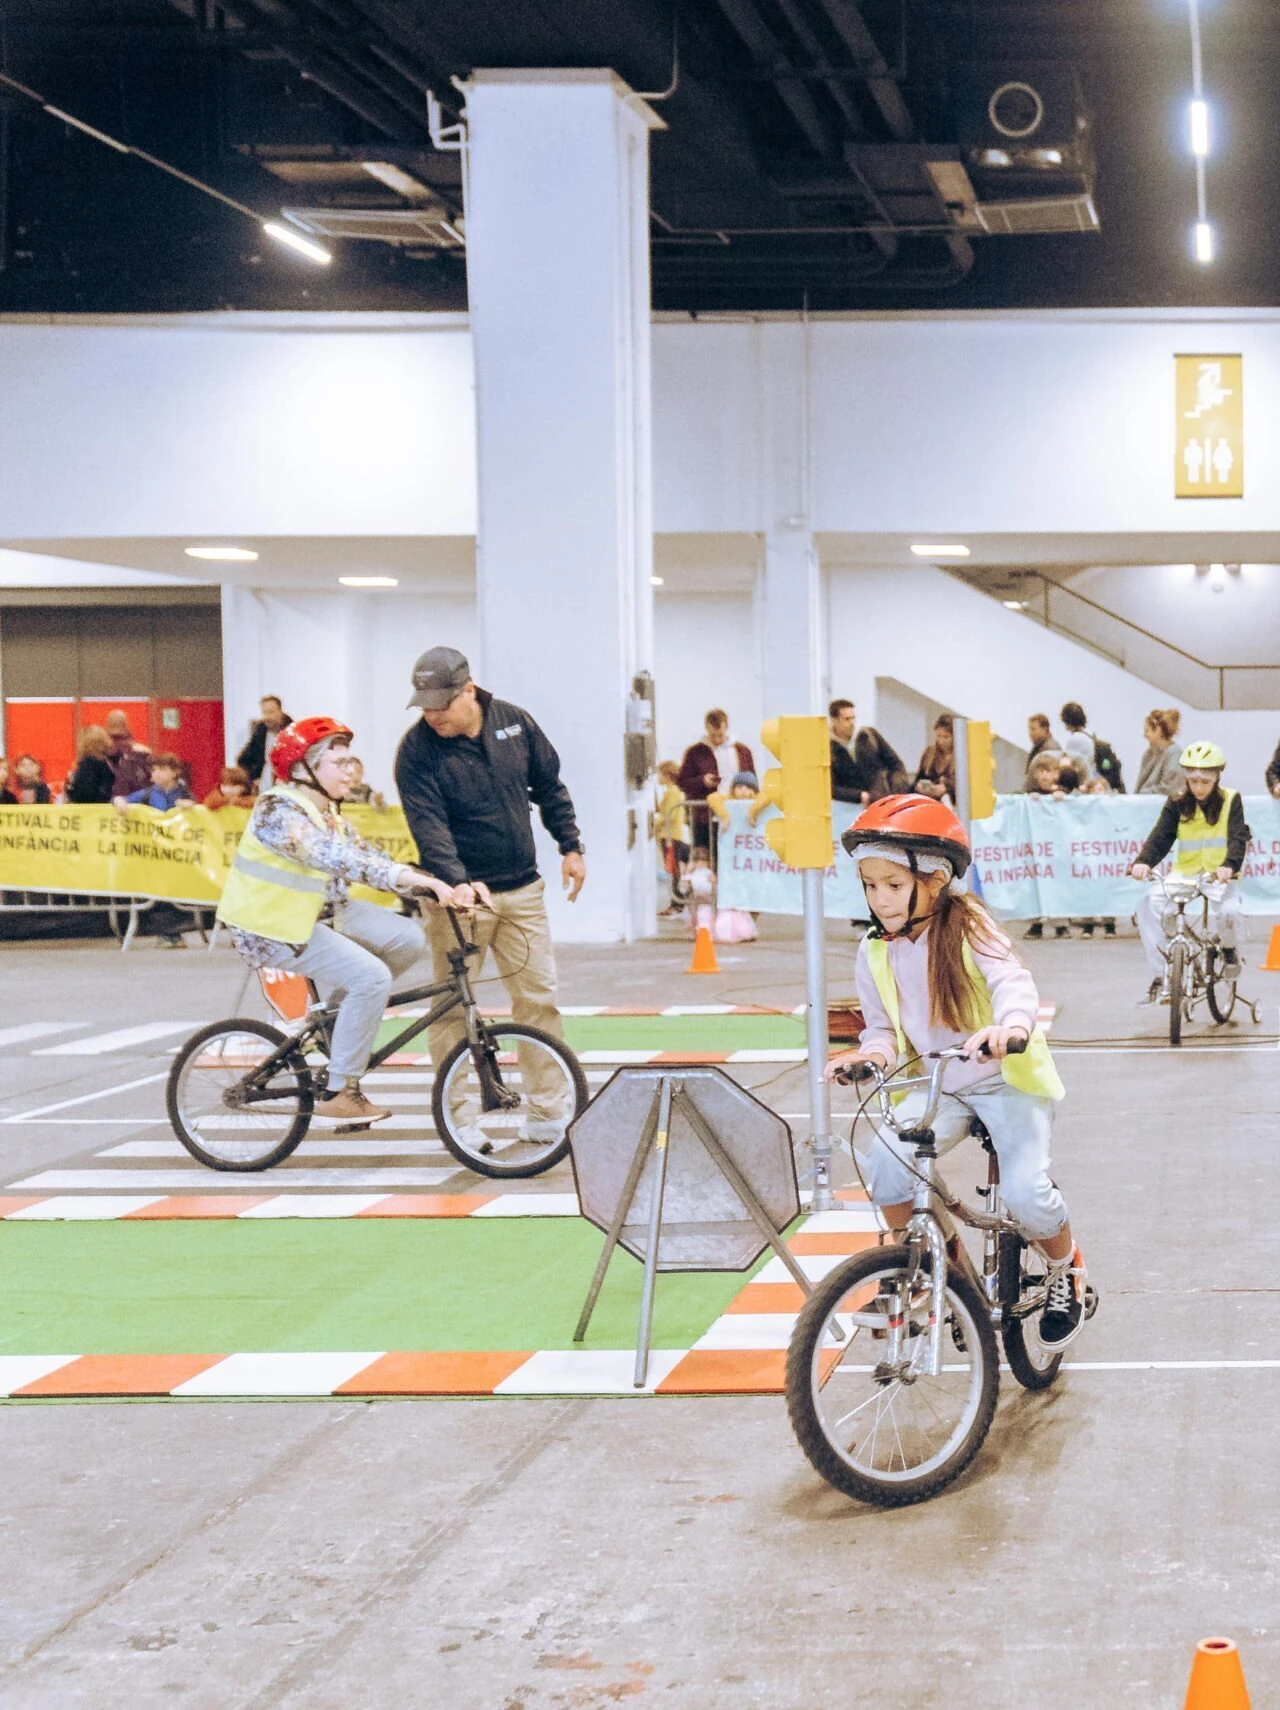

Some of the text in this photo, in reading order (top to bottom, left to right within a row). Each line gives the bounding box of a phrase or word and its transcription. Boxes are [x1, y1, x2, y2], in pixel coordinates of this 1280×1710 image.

[59, 815, 81, 831] DE
[98, 840, 203, 865] LA INFÀNCIA
[1071, 839, 1144, 857] FESTIVA
[732, 856, 753, 872] LA
[1071, 863, 1092, 879] LA
